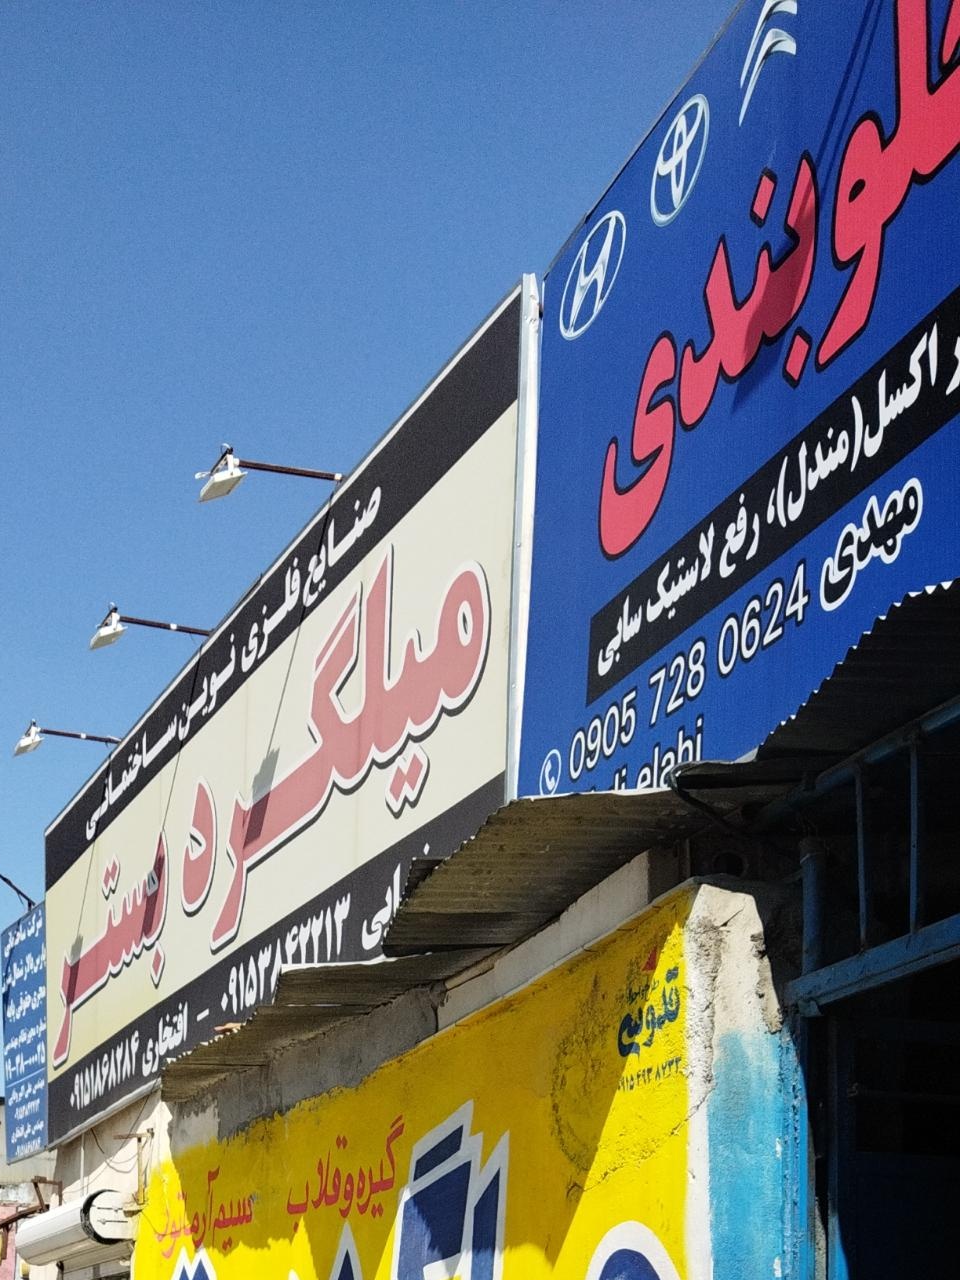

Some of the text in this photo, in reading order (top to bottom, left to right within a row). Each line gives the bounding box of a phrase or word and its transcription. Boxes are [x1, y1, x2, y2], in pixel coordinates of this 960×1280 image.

[646, 522, 715, 620] لاستیک
[718, 493, 760, 580] رفع
[819, 477, 924, 612] مهدی
[85, 486, 382, 841] صنایع فلزی نوین ساختمانی
[568, 562, 809, 781] 0905 728 0624
[52, 544, 492, 1072] میلگرد بستر
[70, 1030, 139, 1111] ۰۹۱۵۱۸۶۸۲۸۴
[141, 1001, 188, 1077] افتخاری
[356, 1115, 405, 1218] گیره
[213, 1198, 253, 1251] سیم
